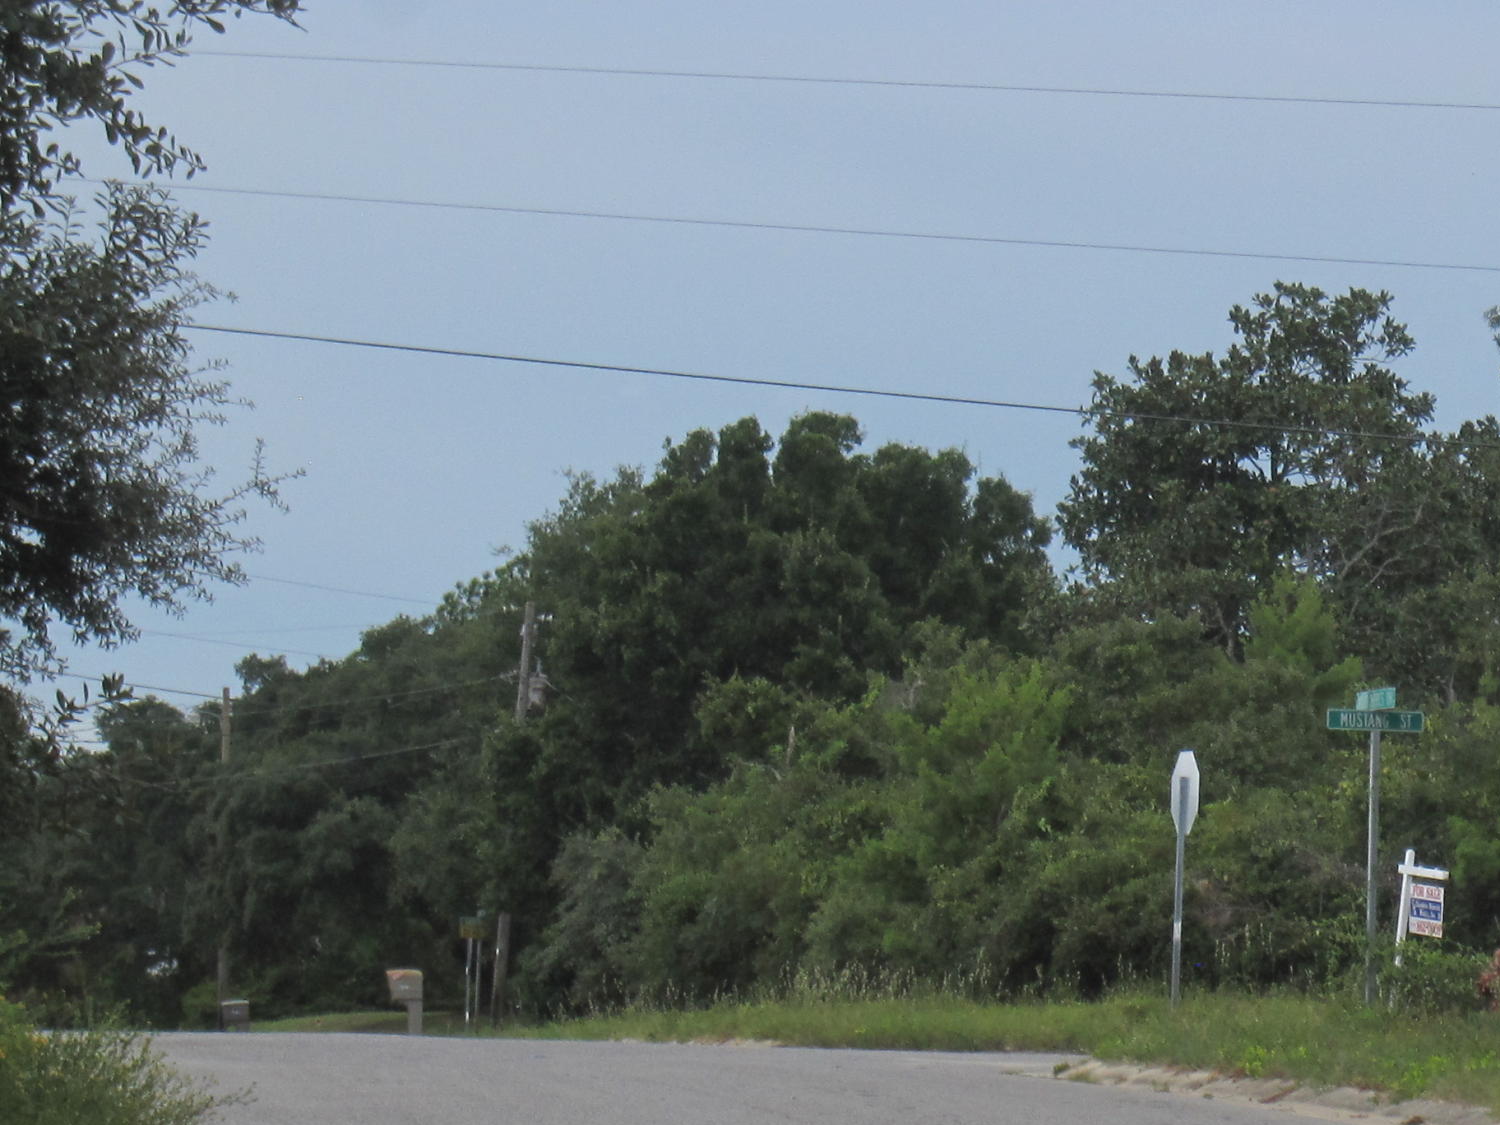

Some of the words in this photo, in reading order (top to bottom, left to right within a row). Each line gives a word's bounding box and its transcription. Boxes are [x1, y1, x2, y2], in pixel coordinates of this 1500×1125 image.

[1340, 712, 1389, 728] MUSTANG
[1400, 714, 1412, 729] ST
[1412, 885, 1425, 897] FOR
[1426, 887, 1441, 900] SALE
